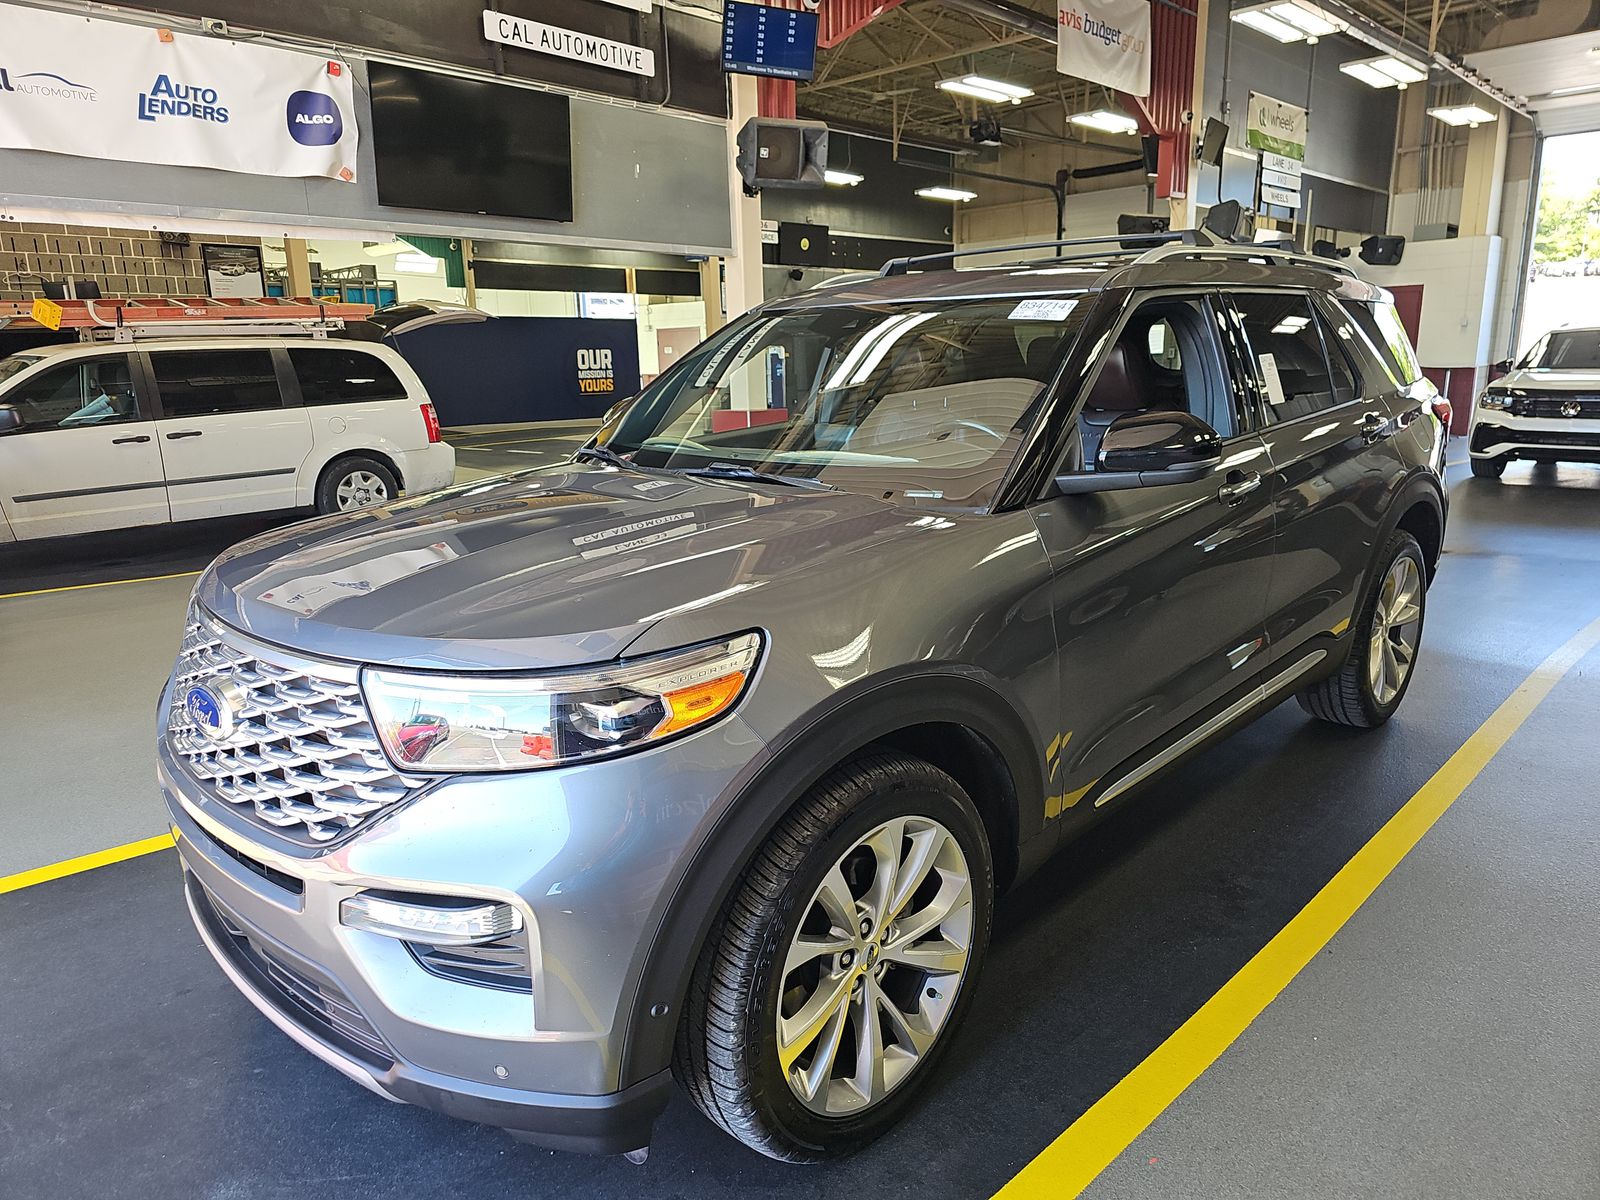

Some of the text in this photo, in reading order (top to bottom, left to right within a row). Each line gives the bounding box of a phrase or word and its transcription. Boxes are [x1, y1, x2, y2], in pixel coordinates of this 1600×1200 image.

[1059, 8, 1082, 31] avis
[1083, 13, 1122, 46] budget
[498, 18, 643, 69] CAL AUTOMOTIVE
[16, 84, 97, 102] AUTOMOTIVE
[295, 113, 334, 125] ALGO
[1270, 110, 1294, 133] wheels
[1270, 192, 1289, 204] WHEELS
[577, 349, 613, 370] OUR
[578, 369, 614, 379] MISSION IS
[579, 378, 614, 392] YOURS
[657, 660, 739, 689] EXPLORER
[189, 693, 213, 727] Ford
